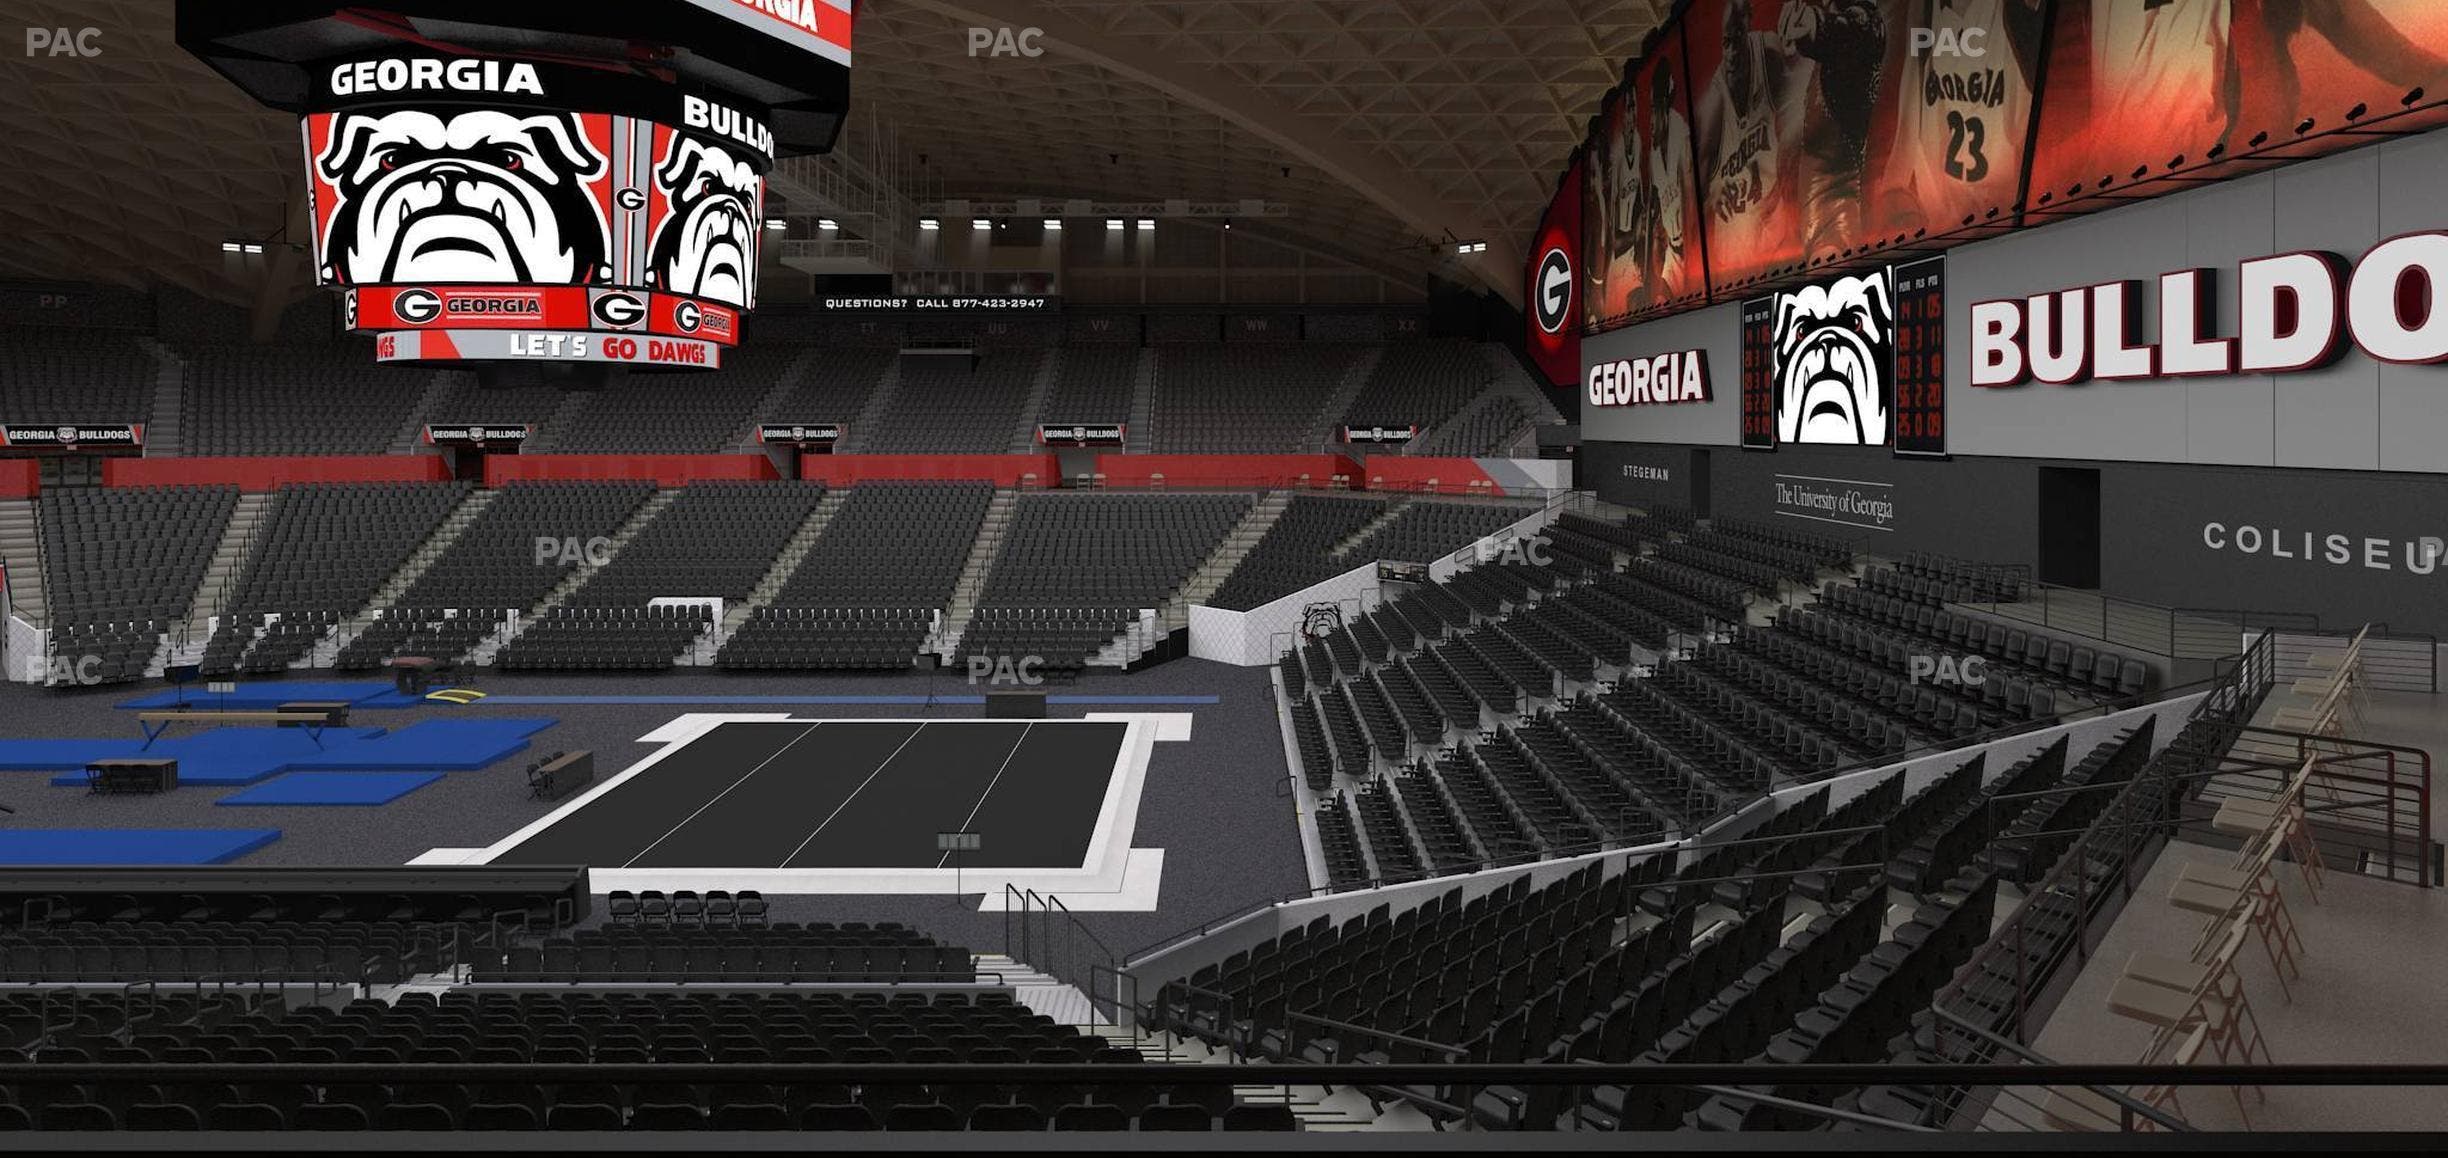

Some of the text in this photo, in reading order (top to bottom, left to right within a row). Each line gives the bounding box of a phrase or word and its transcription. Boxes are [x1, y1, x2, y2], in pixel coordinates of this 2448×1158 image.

[331, 58, 545, 96] GEORGIA
[684, 95, 774, 159] BULLDO
[1945, 110, 1988, 182] 23
[393, 288, 541, 324] G GEORGIA
[825, 298, 1045, 309] QUESTIONS? CALL 877-423-2947
[1535, 248, 1572, 333] G
[591, 291, 648, 329] G
[673, 300, 702, 334] G
[1971, 233, 2448, 387] BULLDO
[510, 333, 705, 364] LET'S GO DAWGS
[1589, 350, 1705, 407] GEORGIA
[9, 430, 131, 439] GEORGIA BULLDOGS
[433, 430, 527, 439] GEORGIA BULLDOGS
[805, 430, 838, 438] BULLDOGS
[1086, 430, 1119, 438] BULLDOGS
[1623, 464, 1669, 481] STEGEMAN
[1776, 482, 1894, 524] The University of Georgia
[2203, 522, 2436, 575] COLISEU
